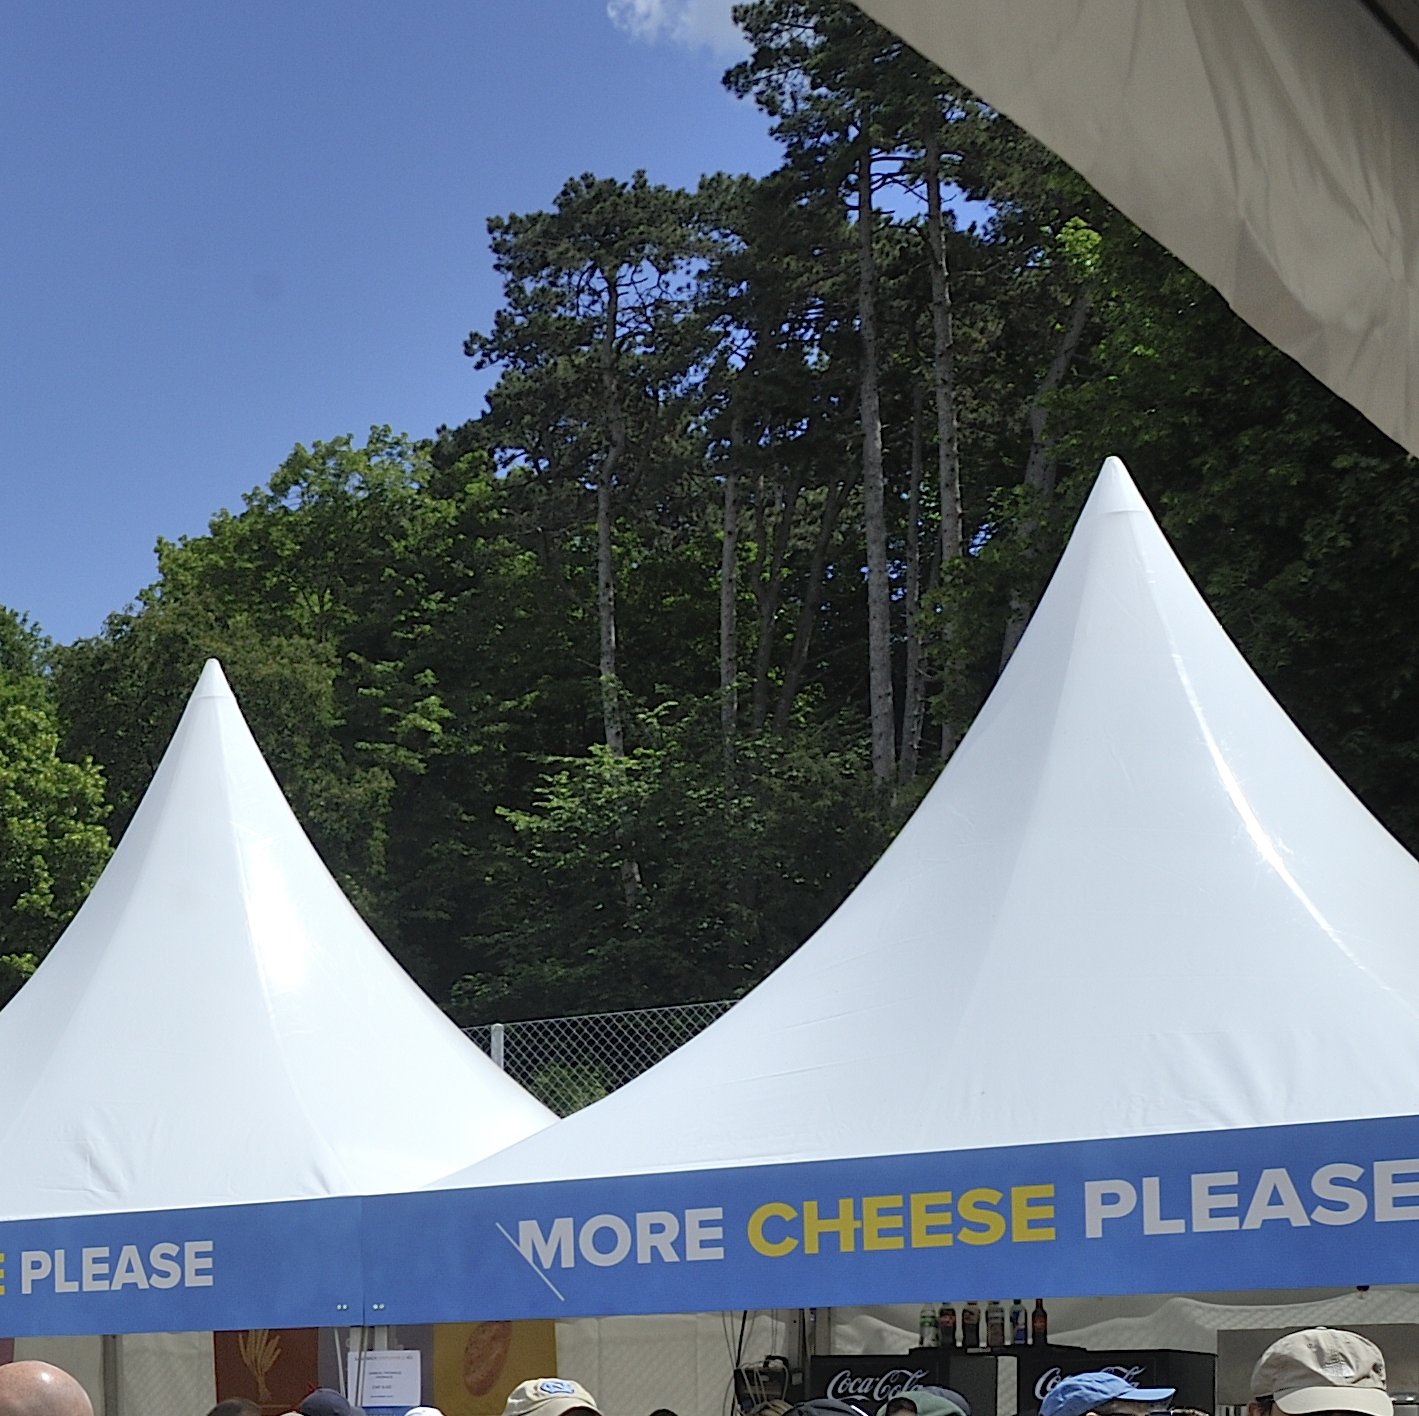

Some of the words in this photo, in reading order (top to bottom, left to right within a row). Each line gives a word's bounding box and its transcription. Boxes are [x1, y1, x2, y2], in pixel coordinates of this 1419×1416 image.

[518, 1206, 724, 1270] MORE
[747, 1183, 1056, 1258] CHEESE
[1084, 1159, 1419, 1239] PLEASE
[20, 1240, 214, 1295] PLEASE
